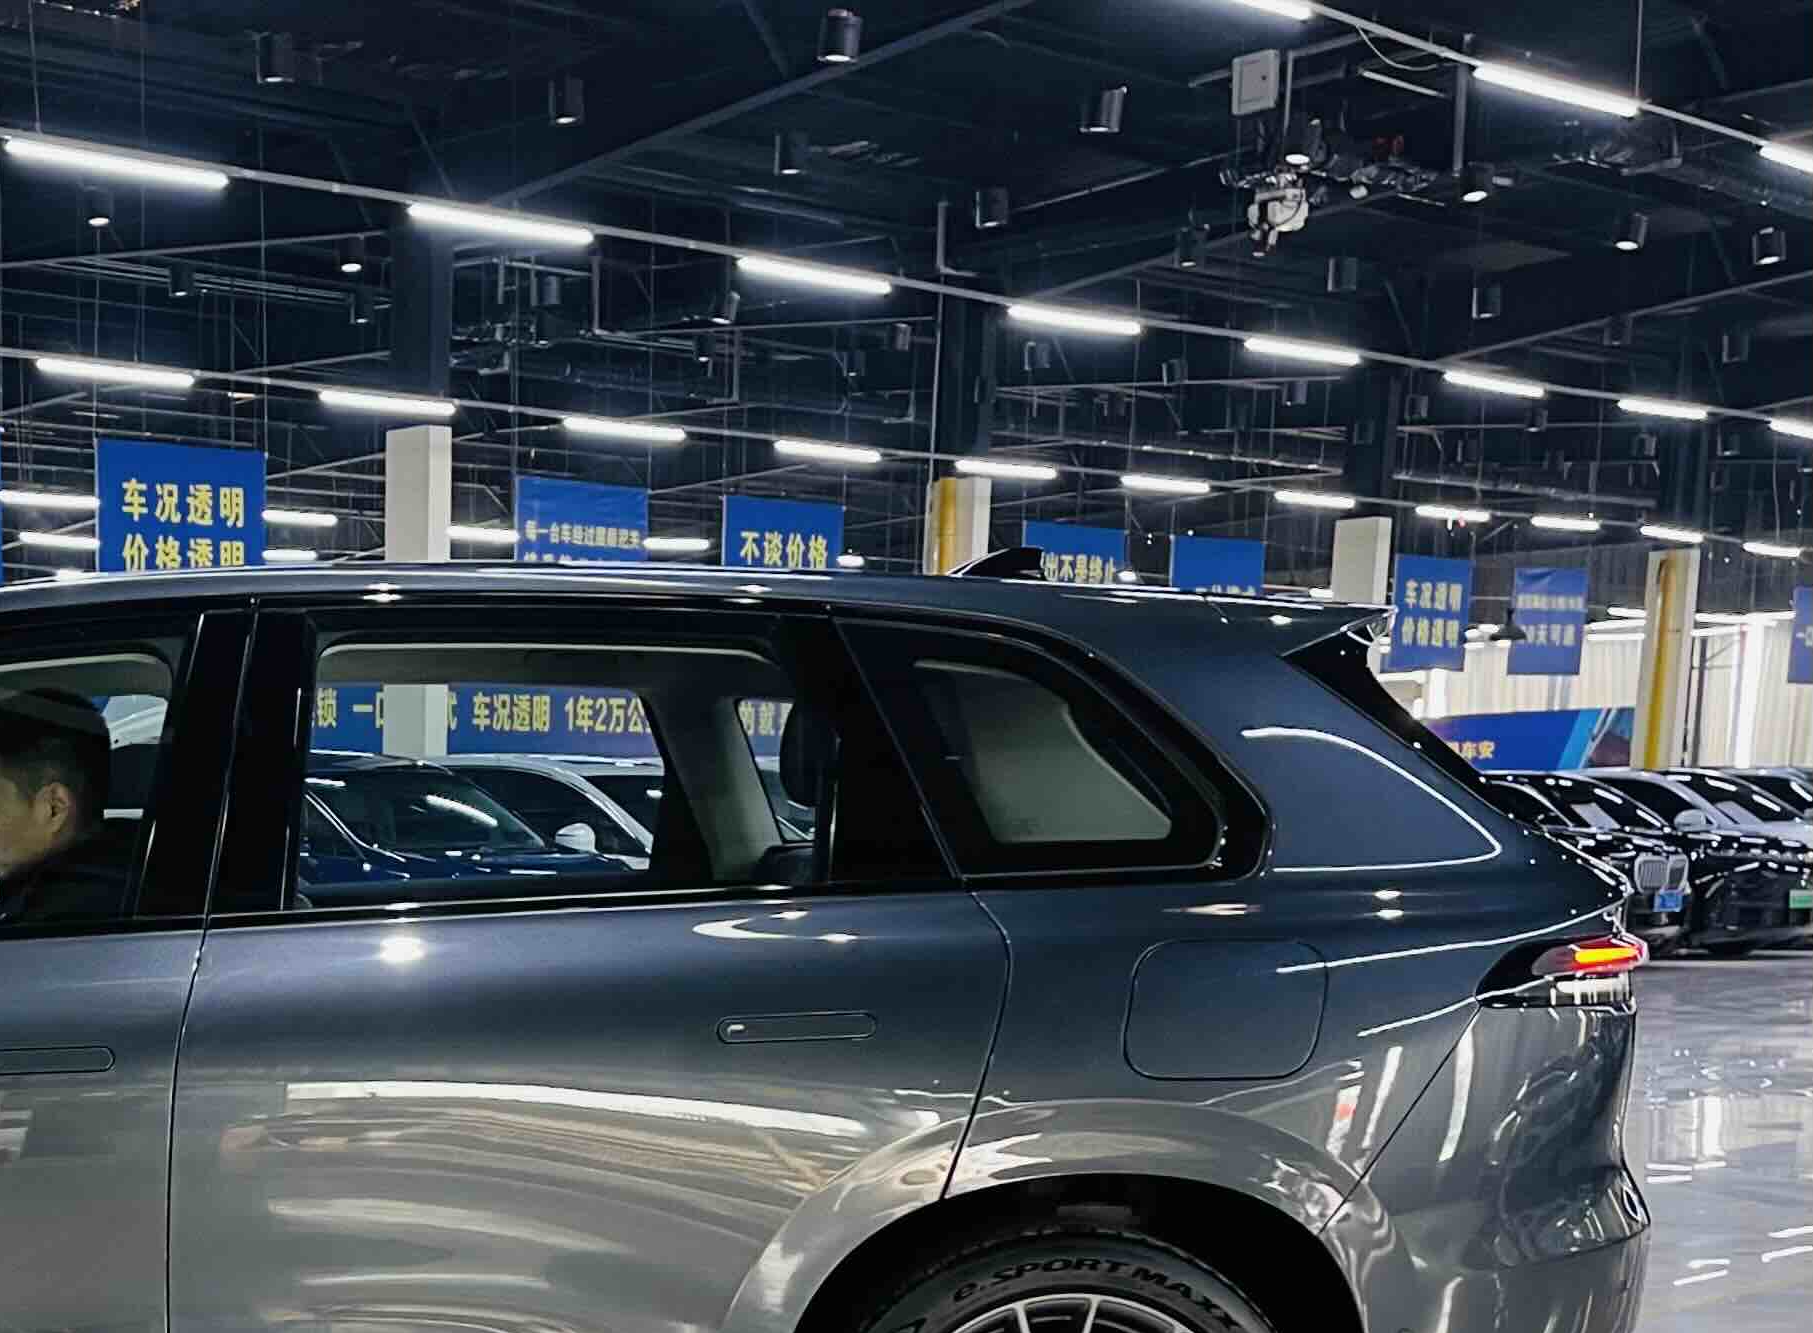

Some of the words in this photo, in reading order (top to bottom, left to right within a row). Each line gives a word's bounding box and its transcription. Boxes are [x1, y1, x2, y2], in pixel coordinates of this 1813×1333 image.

[121, 477, 245, 528] 车况透明
[121, 533, 246, 571] 价格透明
[473, 691, 551, 732] 车况透明
[564, 695, 652, 734] 1年2万公
